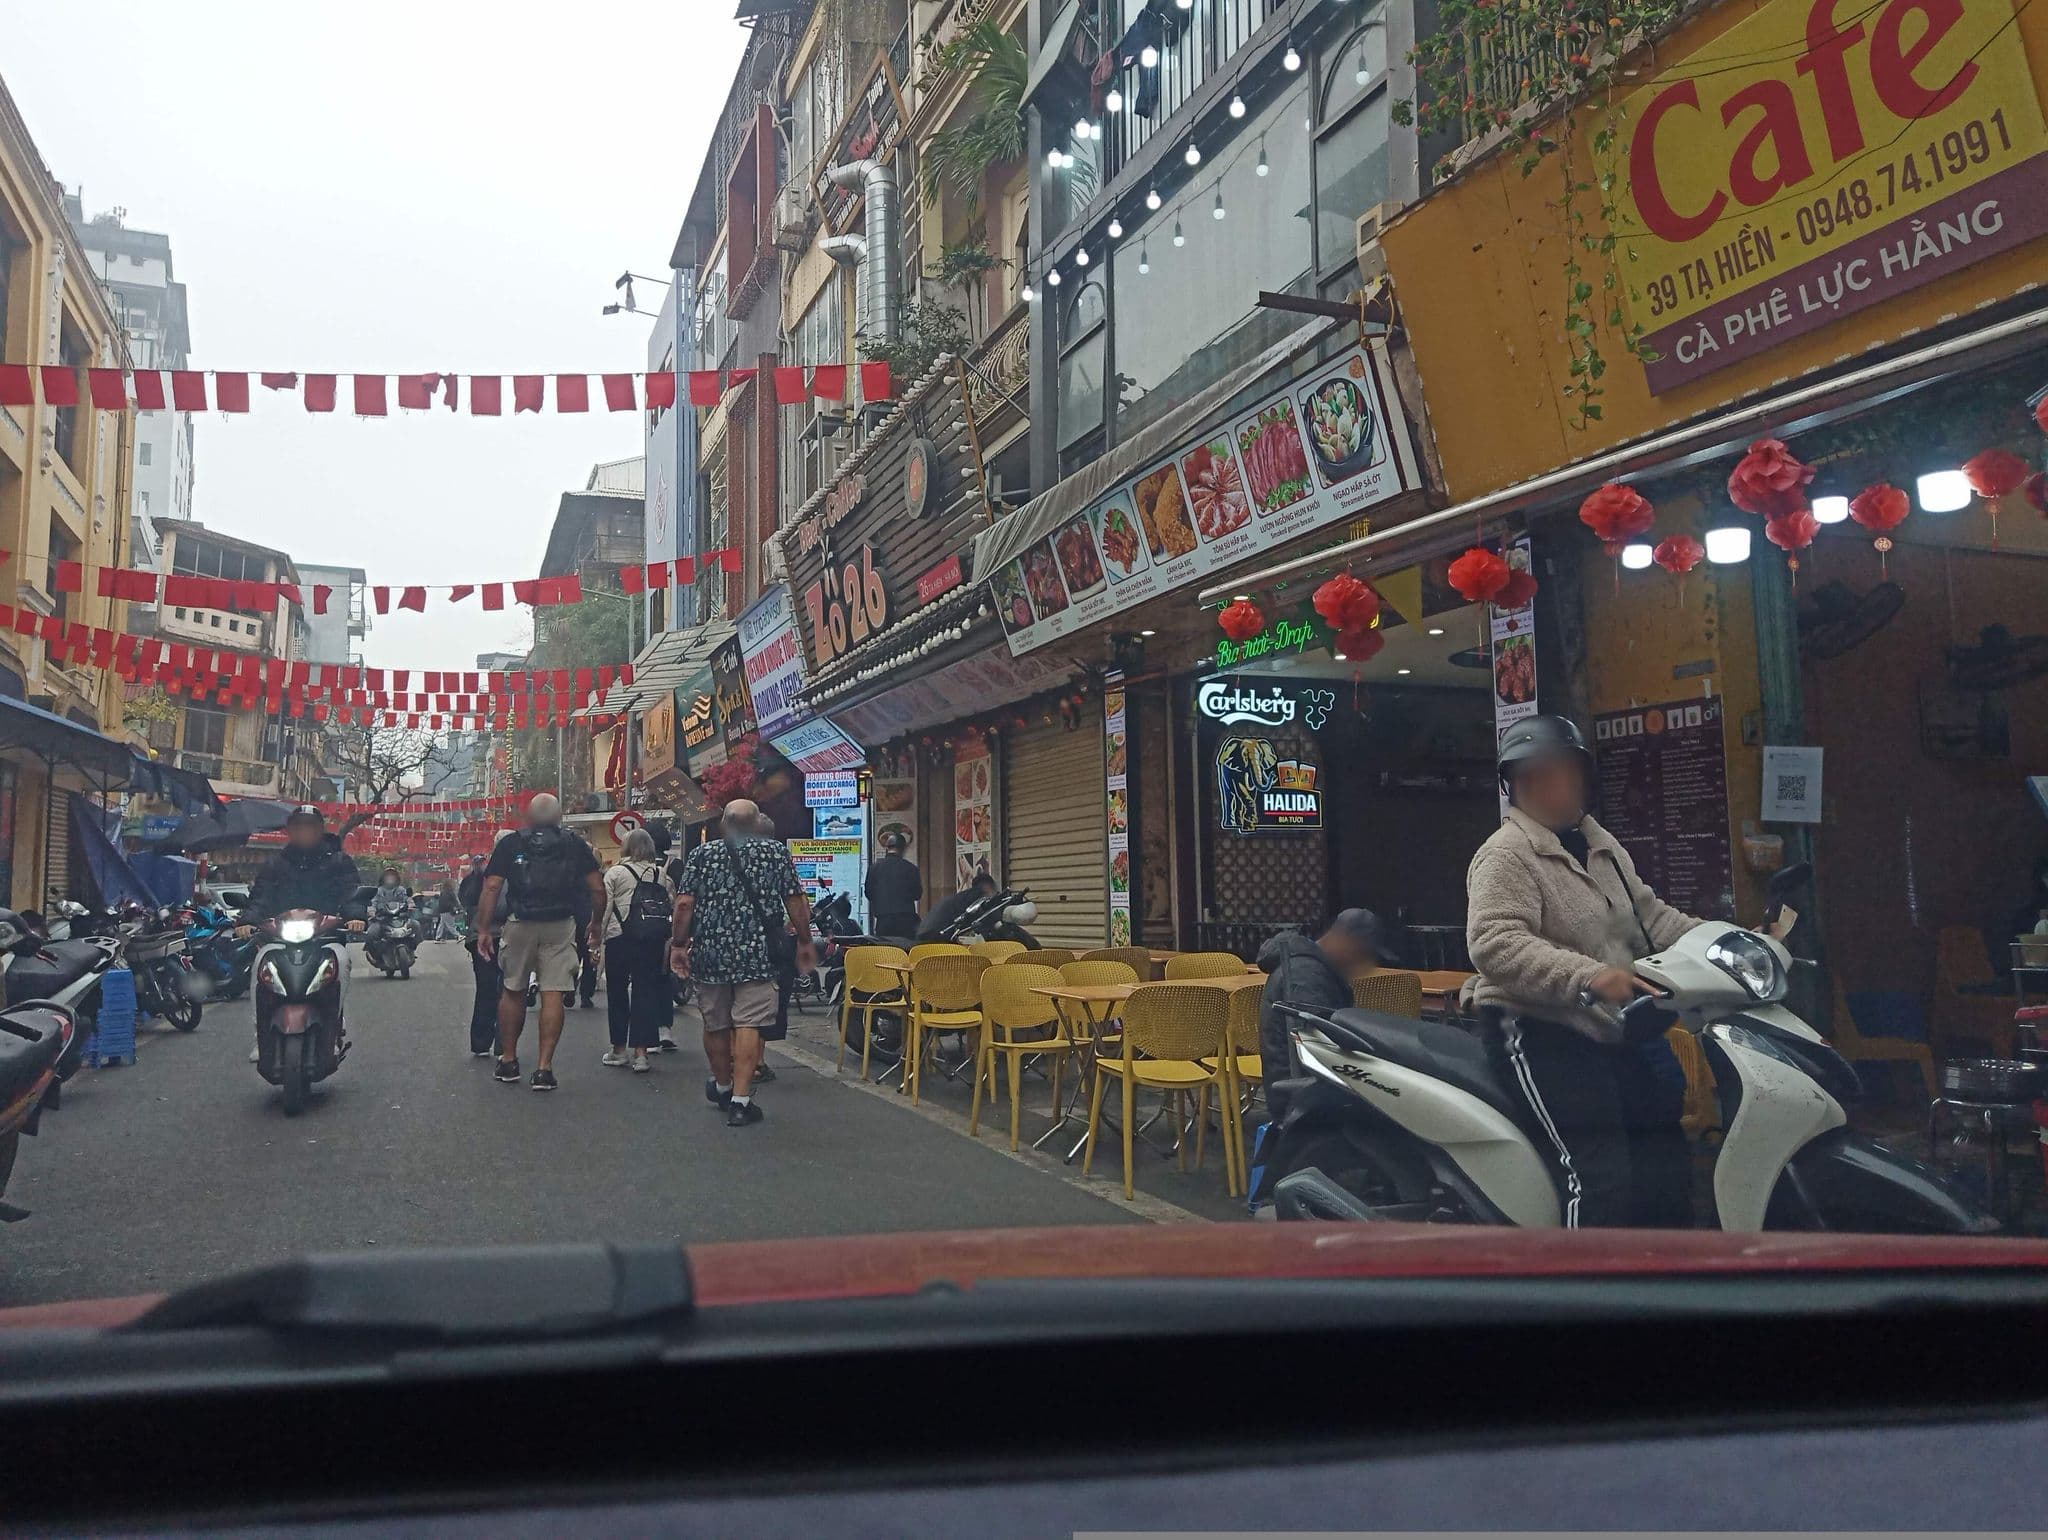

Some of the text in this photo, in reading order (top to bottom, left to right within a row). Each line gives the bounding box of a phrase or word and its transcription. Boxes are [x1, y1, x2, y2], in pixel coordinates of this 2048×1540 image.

[1646, 275, 1677, 316] 39
[1679, 258, 1712, 298] TẠ
[1796, 108, 2012, 247] 0948.74.1991
[1675, 322, 1720, 364] CÀ
[1723, 289, 1792, 345] PHÊ
[1799, 261, 1872, 311] LỰC
[1199, 683, 1296, 724] Carlsberg
[805, 771, 856, 780] BOOKING OFFICE
[806, 780, 856, 789] MONEY EXCHANGE
[1263, 793, 1317, 812] HALIDA
